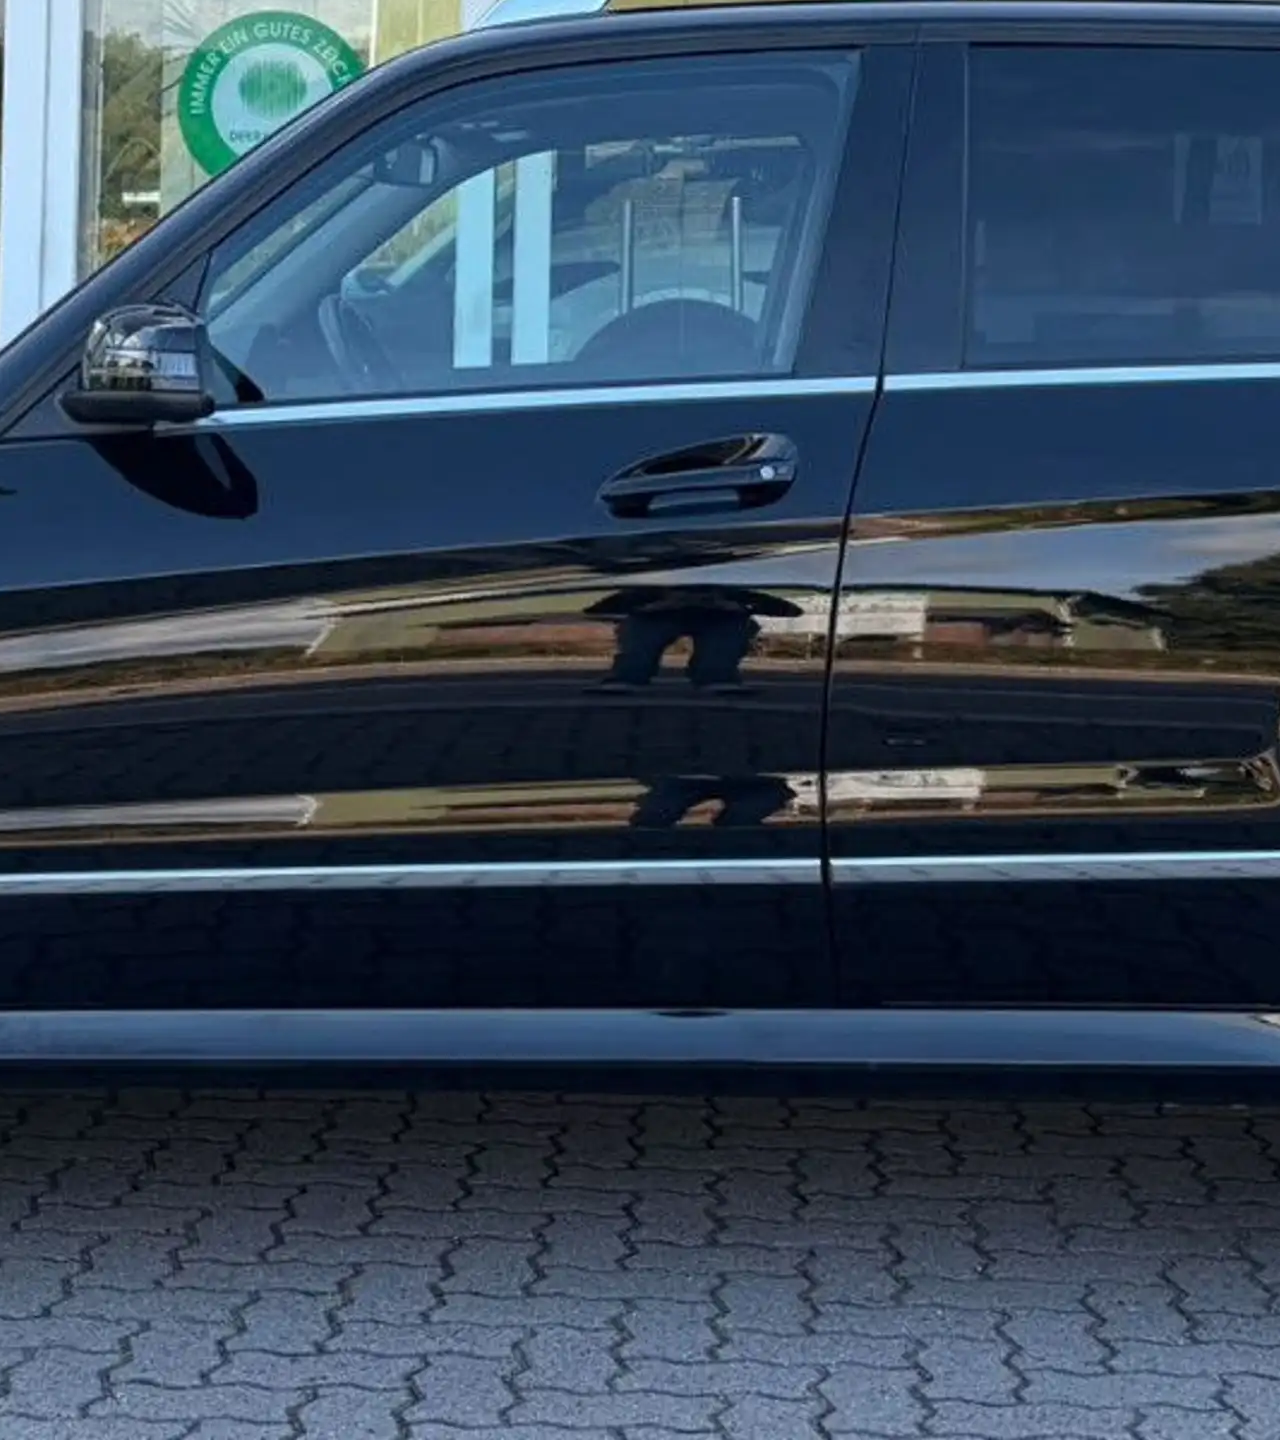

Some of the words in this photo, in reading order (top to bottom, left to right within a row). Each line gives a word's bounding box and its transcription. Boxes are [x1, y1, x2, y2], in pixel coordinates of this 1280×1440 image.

[189, 51, 222, 114] IMMER
[219, 28, 250, 54] EIN
[252, 21, 313, 44] GUTES
